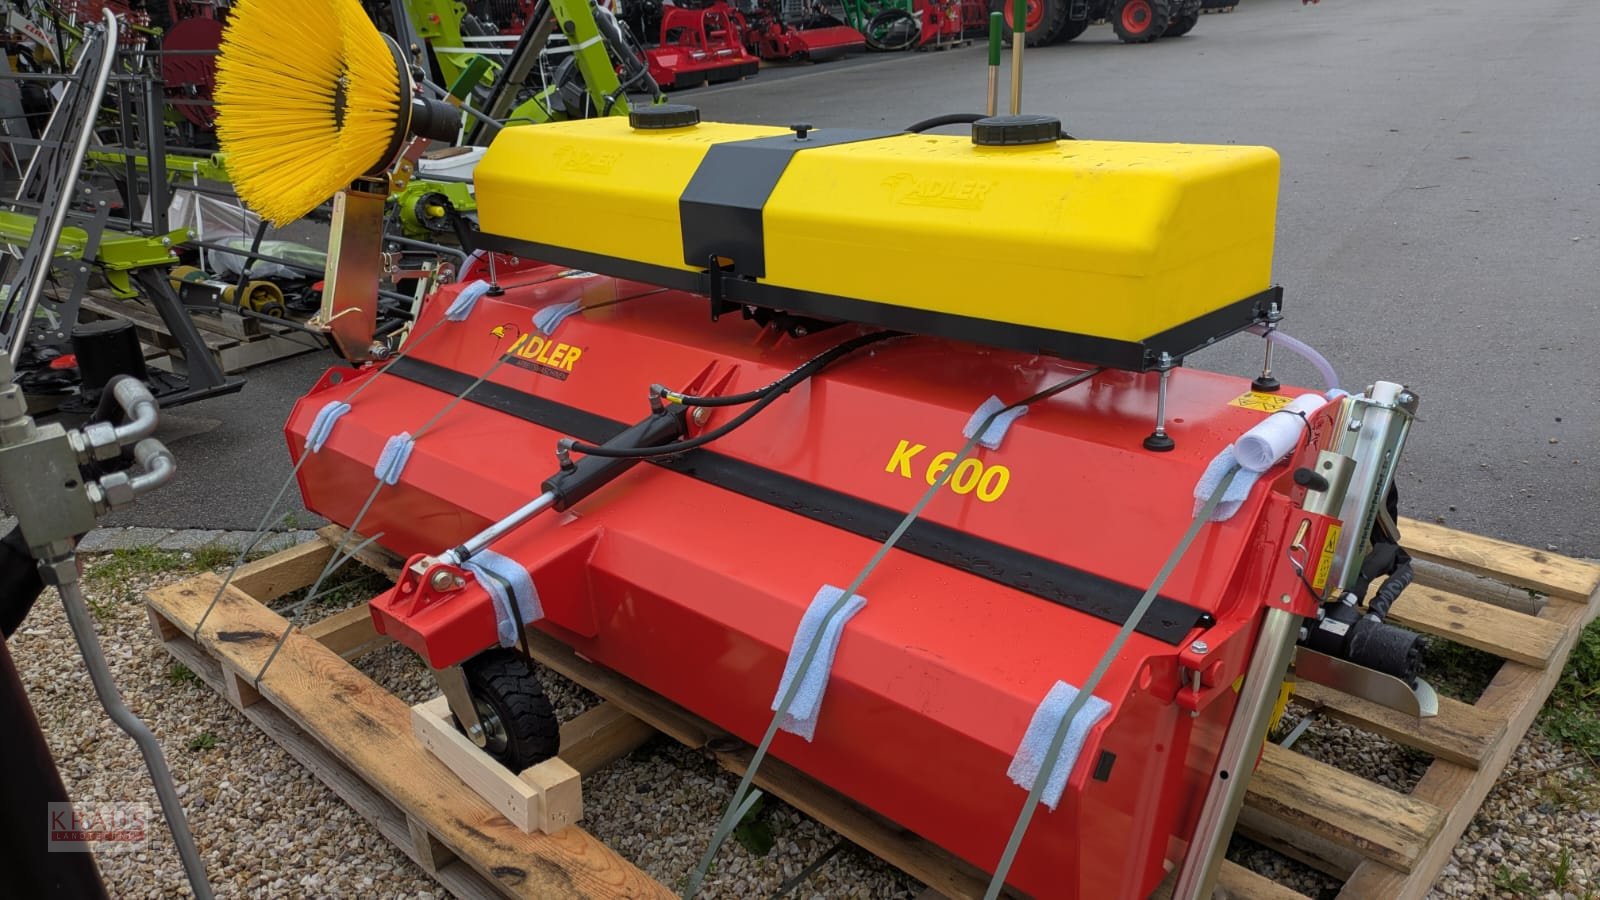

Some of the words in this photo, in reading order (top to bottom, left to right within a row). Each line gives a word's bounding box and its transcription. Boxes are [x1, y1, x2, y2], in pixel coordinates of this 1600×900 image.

[902, 176, 993, 202] ADLER
[507, 333, 582, 372] ADLER
[884, 439, 927, 479] K
[925, 451, 1010, 503] 600
